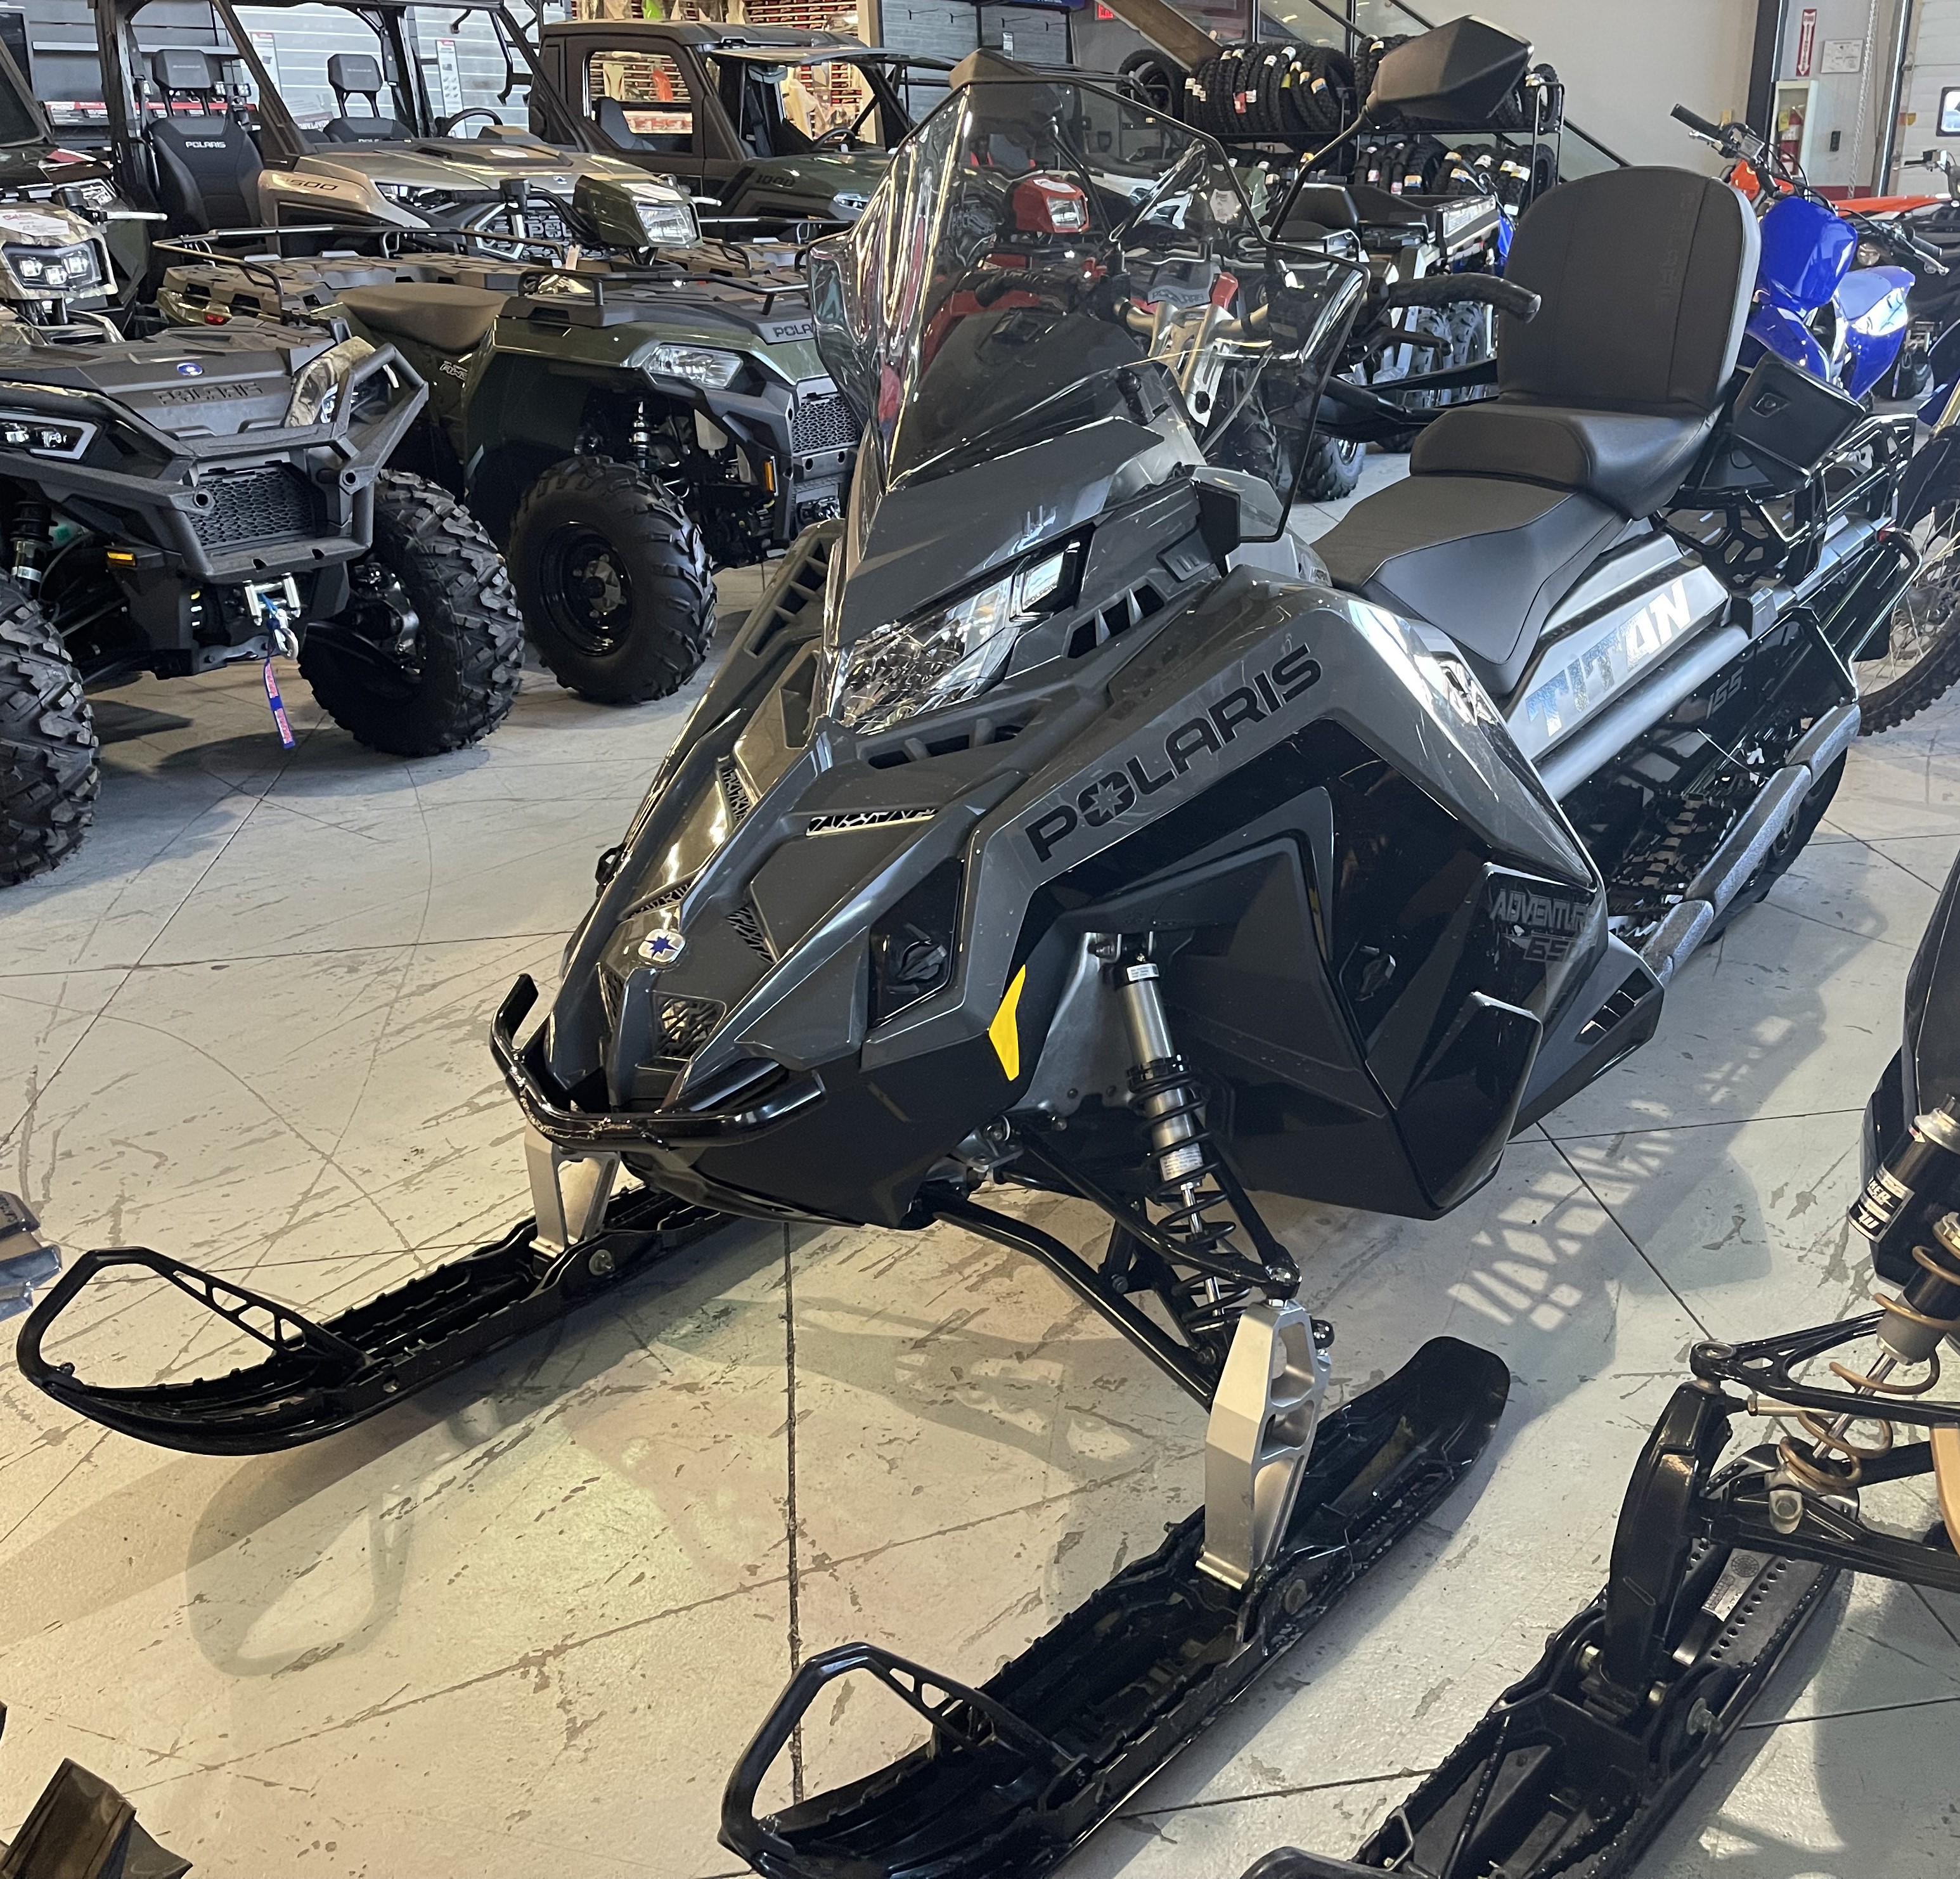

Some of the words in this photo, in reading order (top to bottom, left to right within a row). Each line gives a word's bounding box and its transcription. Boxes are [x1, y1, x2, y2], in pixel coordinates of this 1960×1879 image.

[756, 174, 796, 187] 1000
[1152, 289, 1204, 304] POLARIS
[153, 382, 264, 405] POLARIS
[1525, 578, 1691, 738] TITAN
[1705, 666, 1745, 721] 155
[1024, 642, 1323, 863] POLARIS
